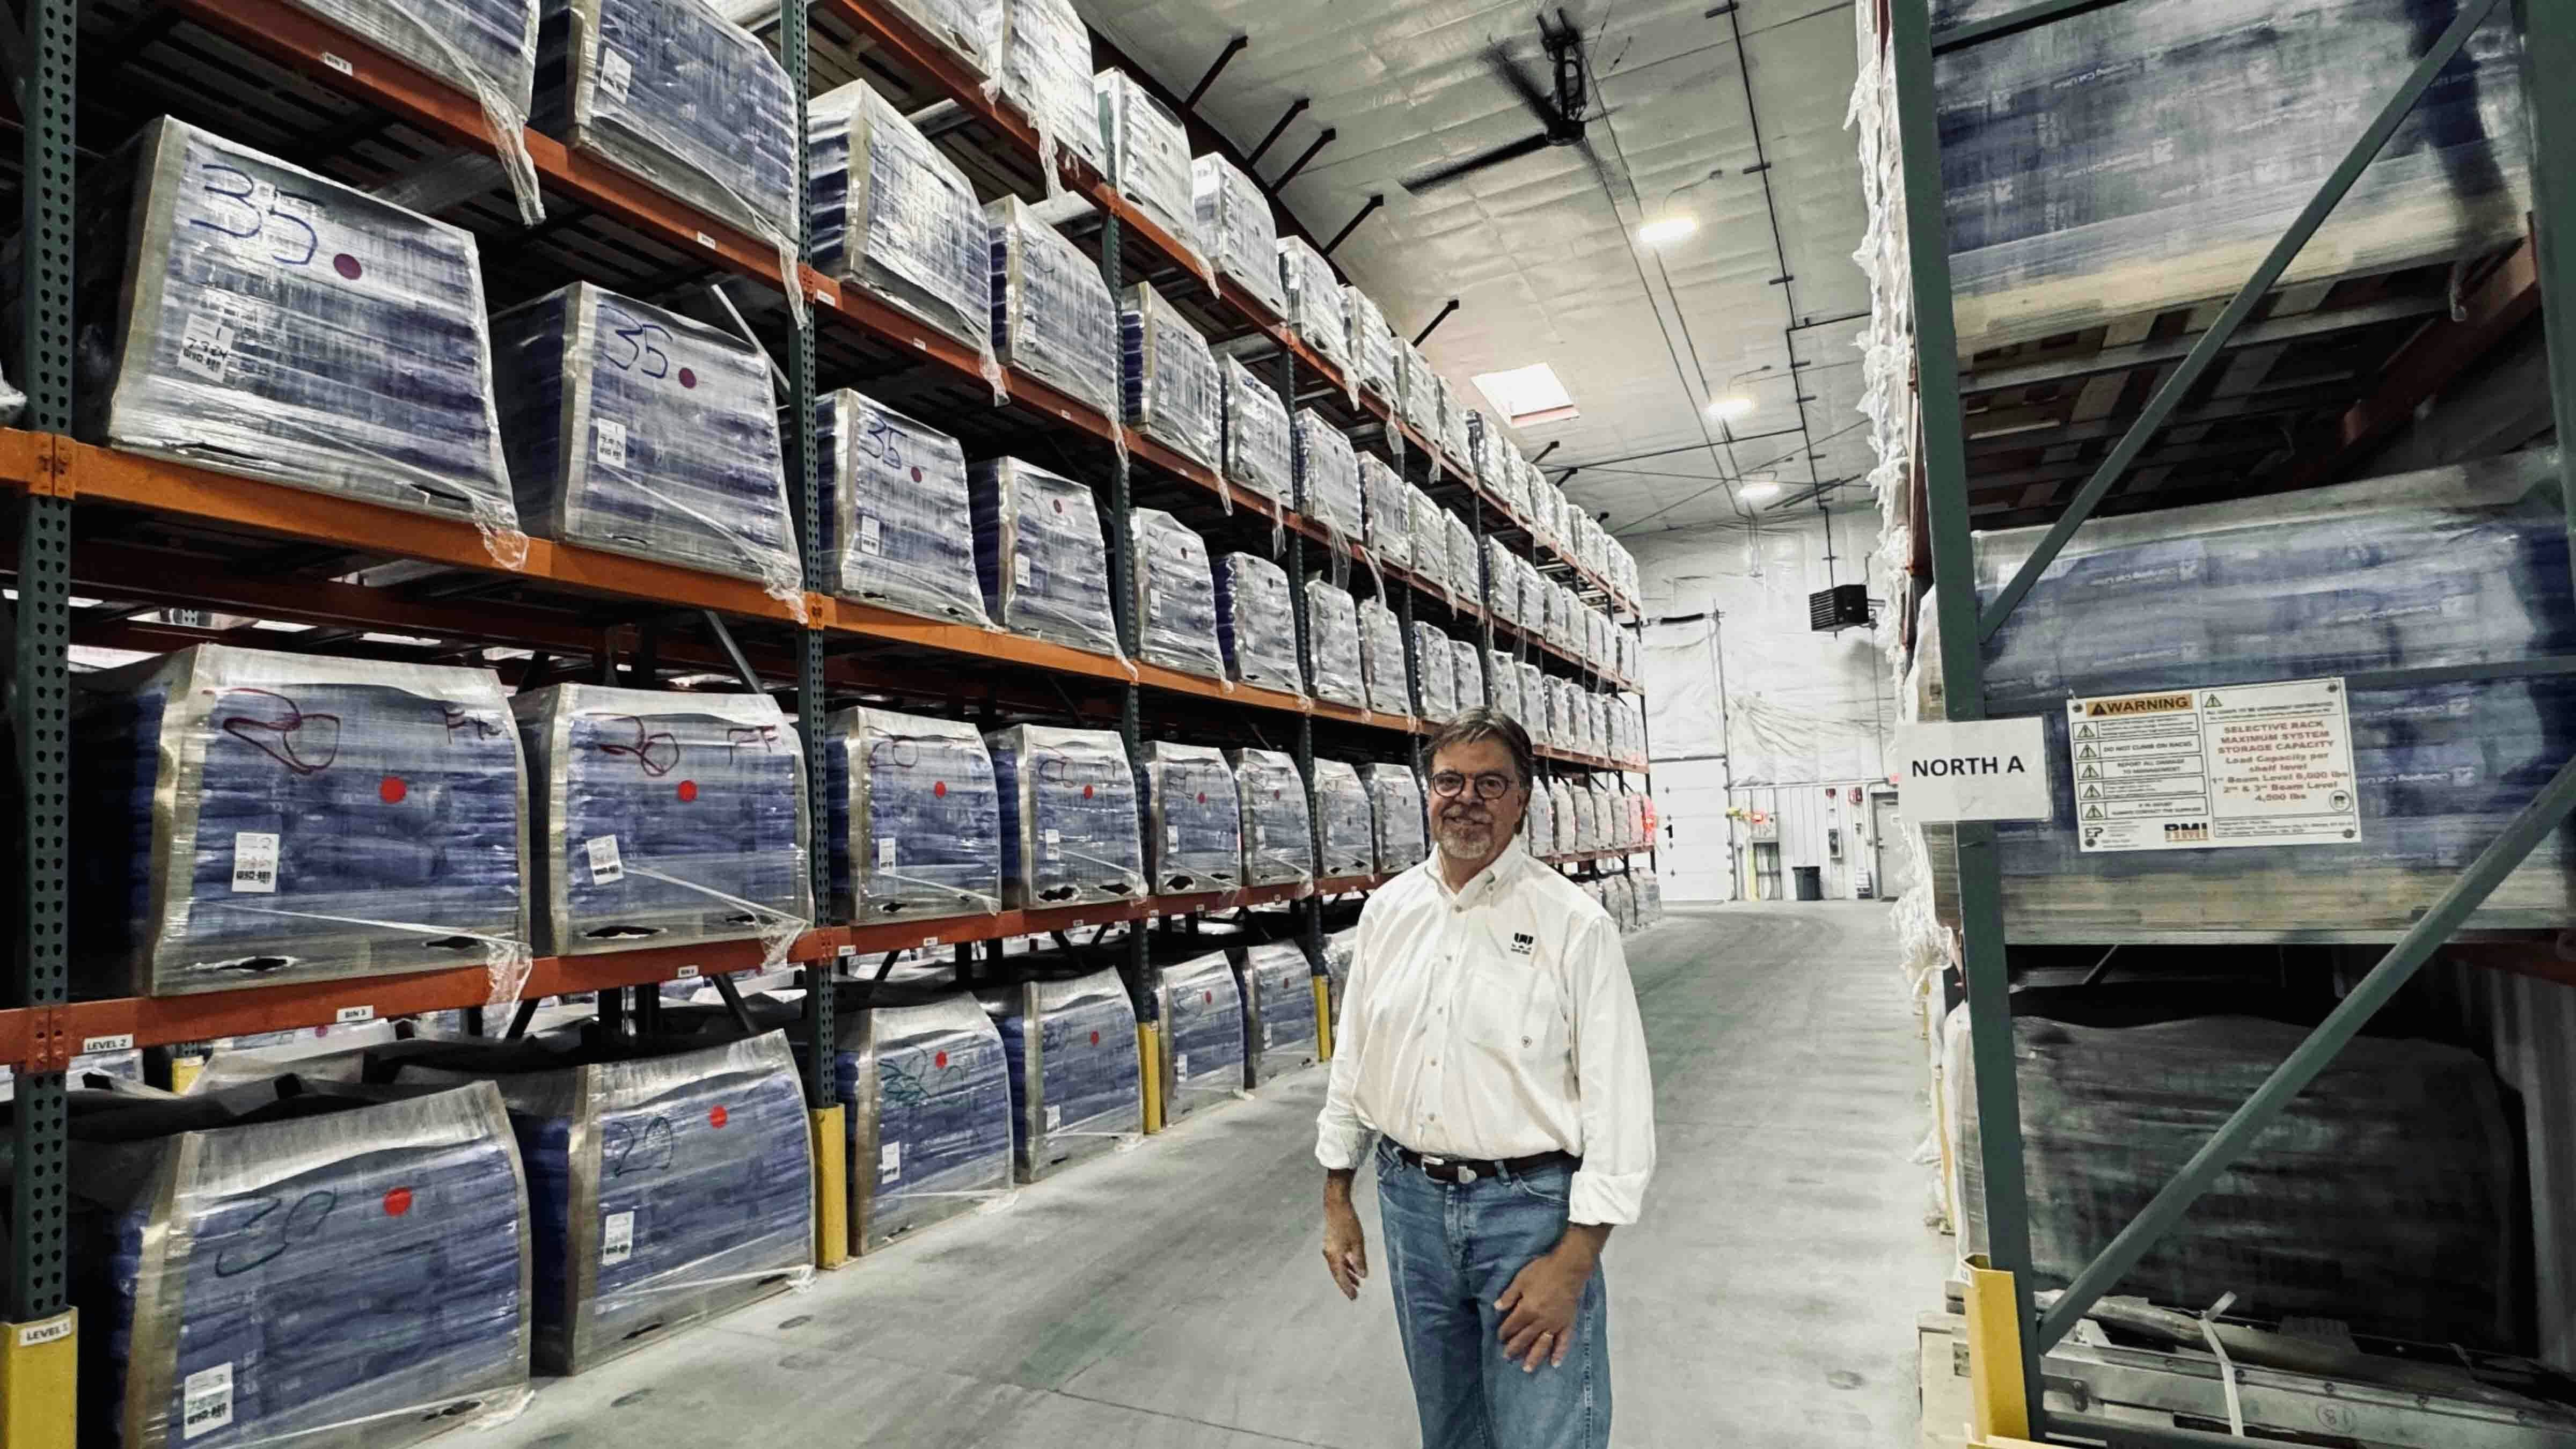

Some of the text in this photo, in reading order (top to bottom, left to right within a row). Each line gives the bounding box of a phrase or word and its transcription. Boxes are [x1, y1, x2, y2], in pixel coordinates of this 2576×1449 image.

[190, 163, 325, 265] 35
[596, 304, 673, 379] 35
[859, 412, 908, 470] 35
[2107, 697, 2189, 713] WARNING
[2223, 721, 2324, 734] SELECTIVE RACK
[2220, 730, 2330, 744] MAXIMUM SYSTEM
[2218, 740, 2335, 754] STORAGE CAPACITY
[2226, 752, 2329, 763] Load Capacity per
[1912, 756, 2025, 778] NORTH A
[2249, 763, 2308, 772] shelf level
[2262, 773, 2294, 781] Level
[2271, 783, 2304, 791] Beam
[2307, 781, 2338, 789] Level
[2254, 793, 2286, 803] 4,500
[1664, 824, 1673, 838] 1
[344, 1009, 359, 1019] BIN
[87, 1039, 127, 1052] LEVEL 2
[26, 1326, 60, 1341] LEVEL
